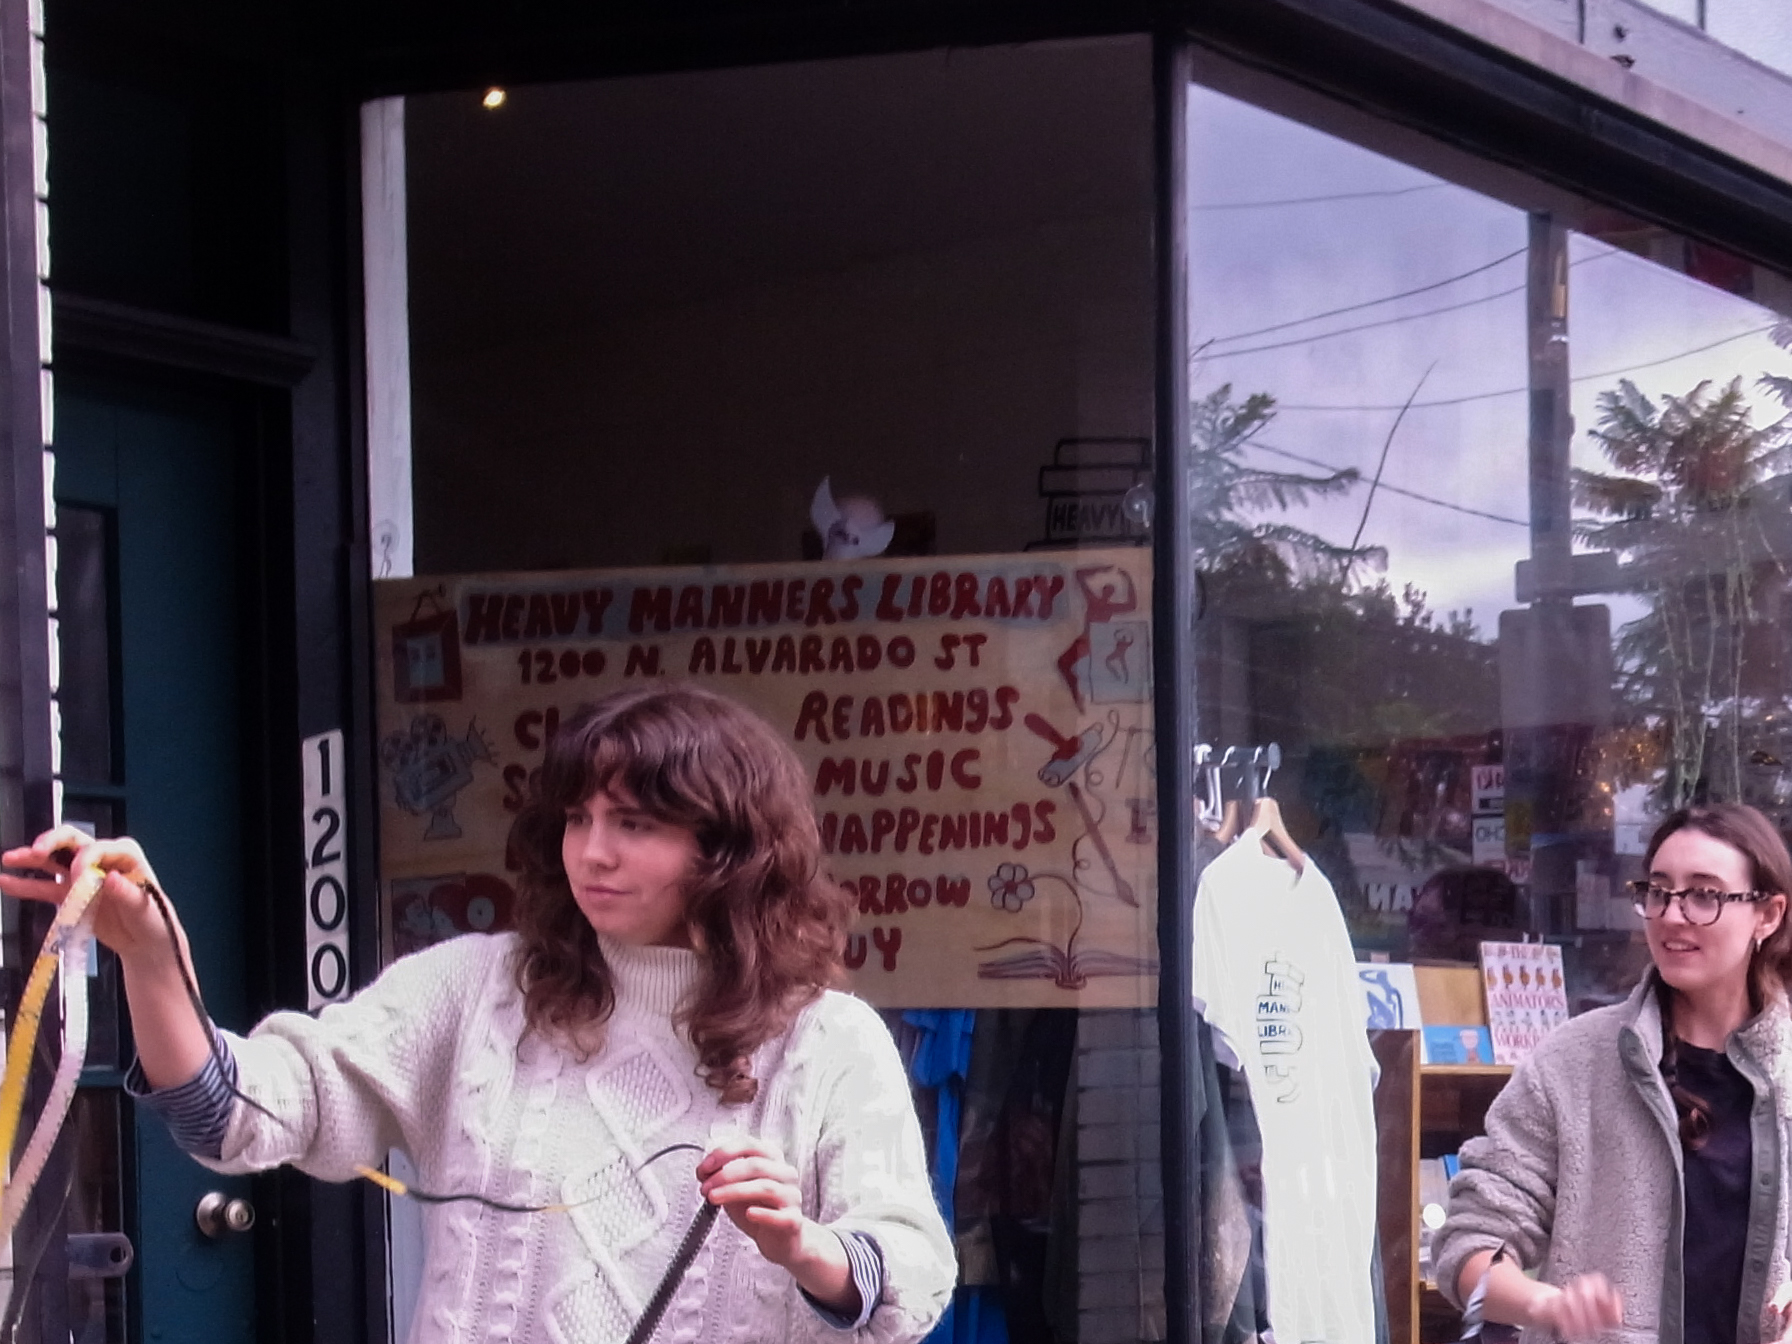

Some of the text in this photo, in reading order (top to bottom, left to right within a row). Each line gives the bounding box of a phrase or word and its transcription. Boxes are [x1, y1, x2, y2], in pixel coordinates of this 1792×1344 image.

[464, 571, 1065, 645] HEAVY MANNERS LIBRARY
[517, 633, 988, 685] 1200 N. ALVARADO ST
[794, 685, 1020, 744] READINGS
[814, 748, 982, 796] MUSIC
[310, 738, 346, 999] 1200
[843, 927, 902, 972] UY
